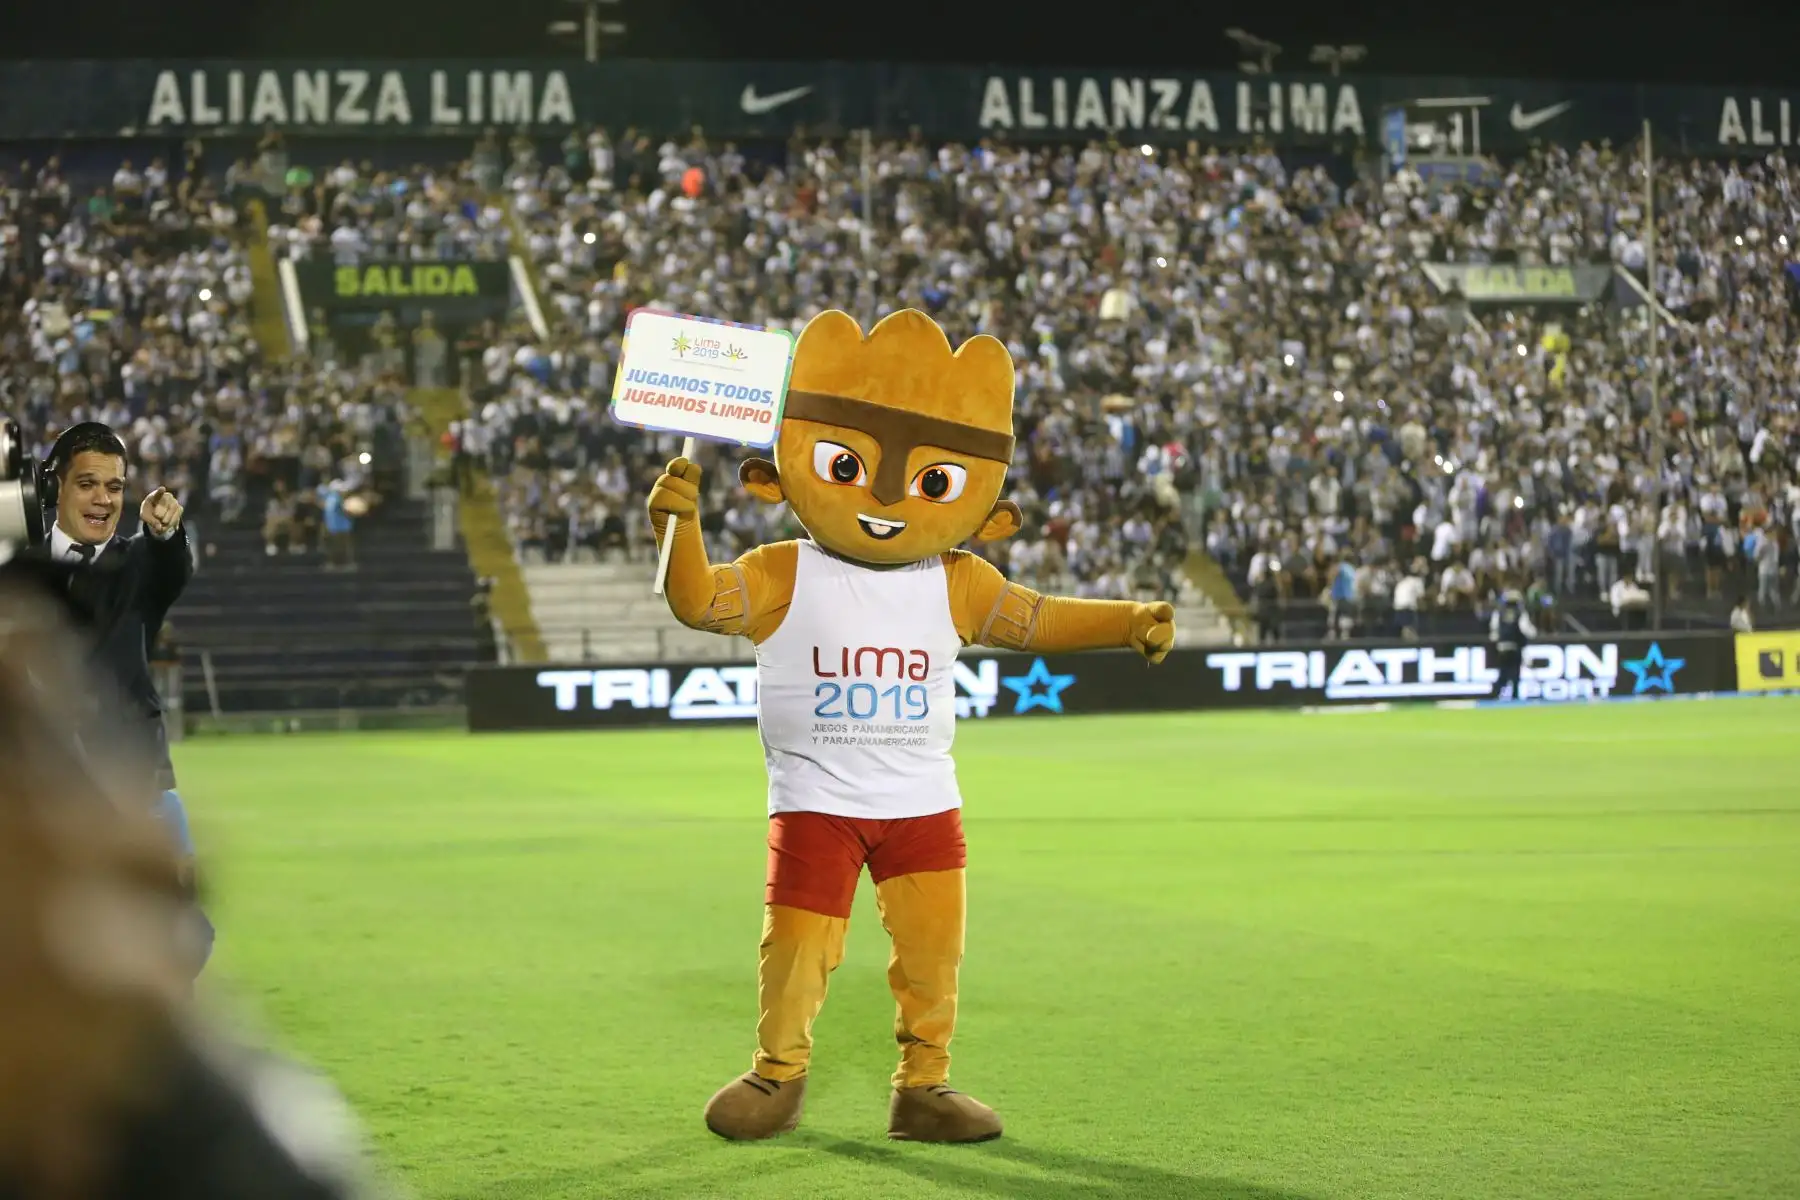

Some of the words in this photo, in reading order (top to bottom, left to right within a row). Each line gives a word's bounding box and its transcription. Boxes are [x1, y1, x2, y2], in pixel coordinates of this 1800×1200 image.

[147, 70, 411, 125] ALIANZA
[430, 70, 575, 125] LIMA
[979, 76, 1219, 131] ALIANZA
[1718, 96, 1800, 147] ALI
[334, 264, 479, 297] SALIDA
[693, 347, 719, 359] 2019
[626, 368, 711, 395] JUGAMOS
[714, 382, 775, 407] TODOS,
[623, 388, 708, 414] JUGAMOS
[709, 402, 773, 425] LIMPIO
[814, 682, 930, 720] 2019
[811, 723, 848, 734] JUEGOS
[852, 724, 930, 735] PANAMERICANOS
[811, 736, 819, 746] Y
[822, 736, 927, 747] PARAPANAMERICANOS
